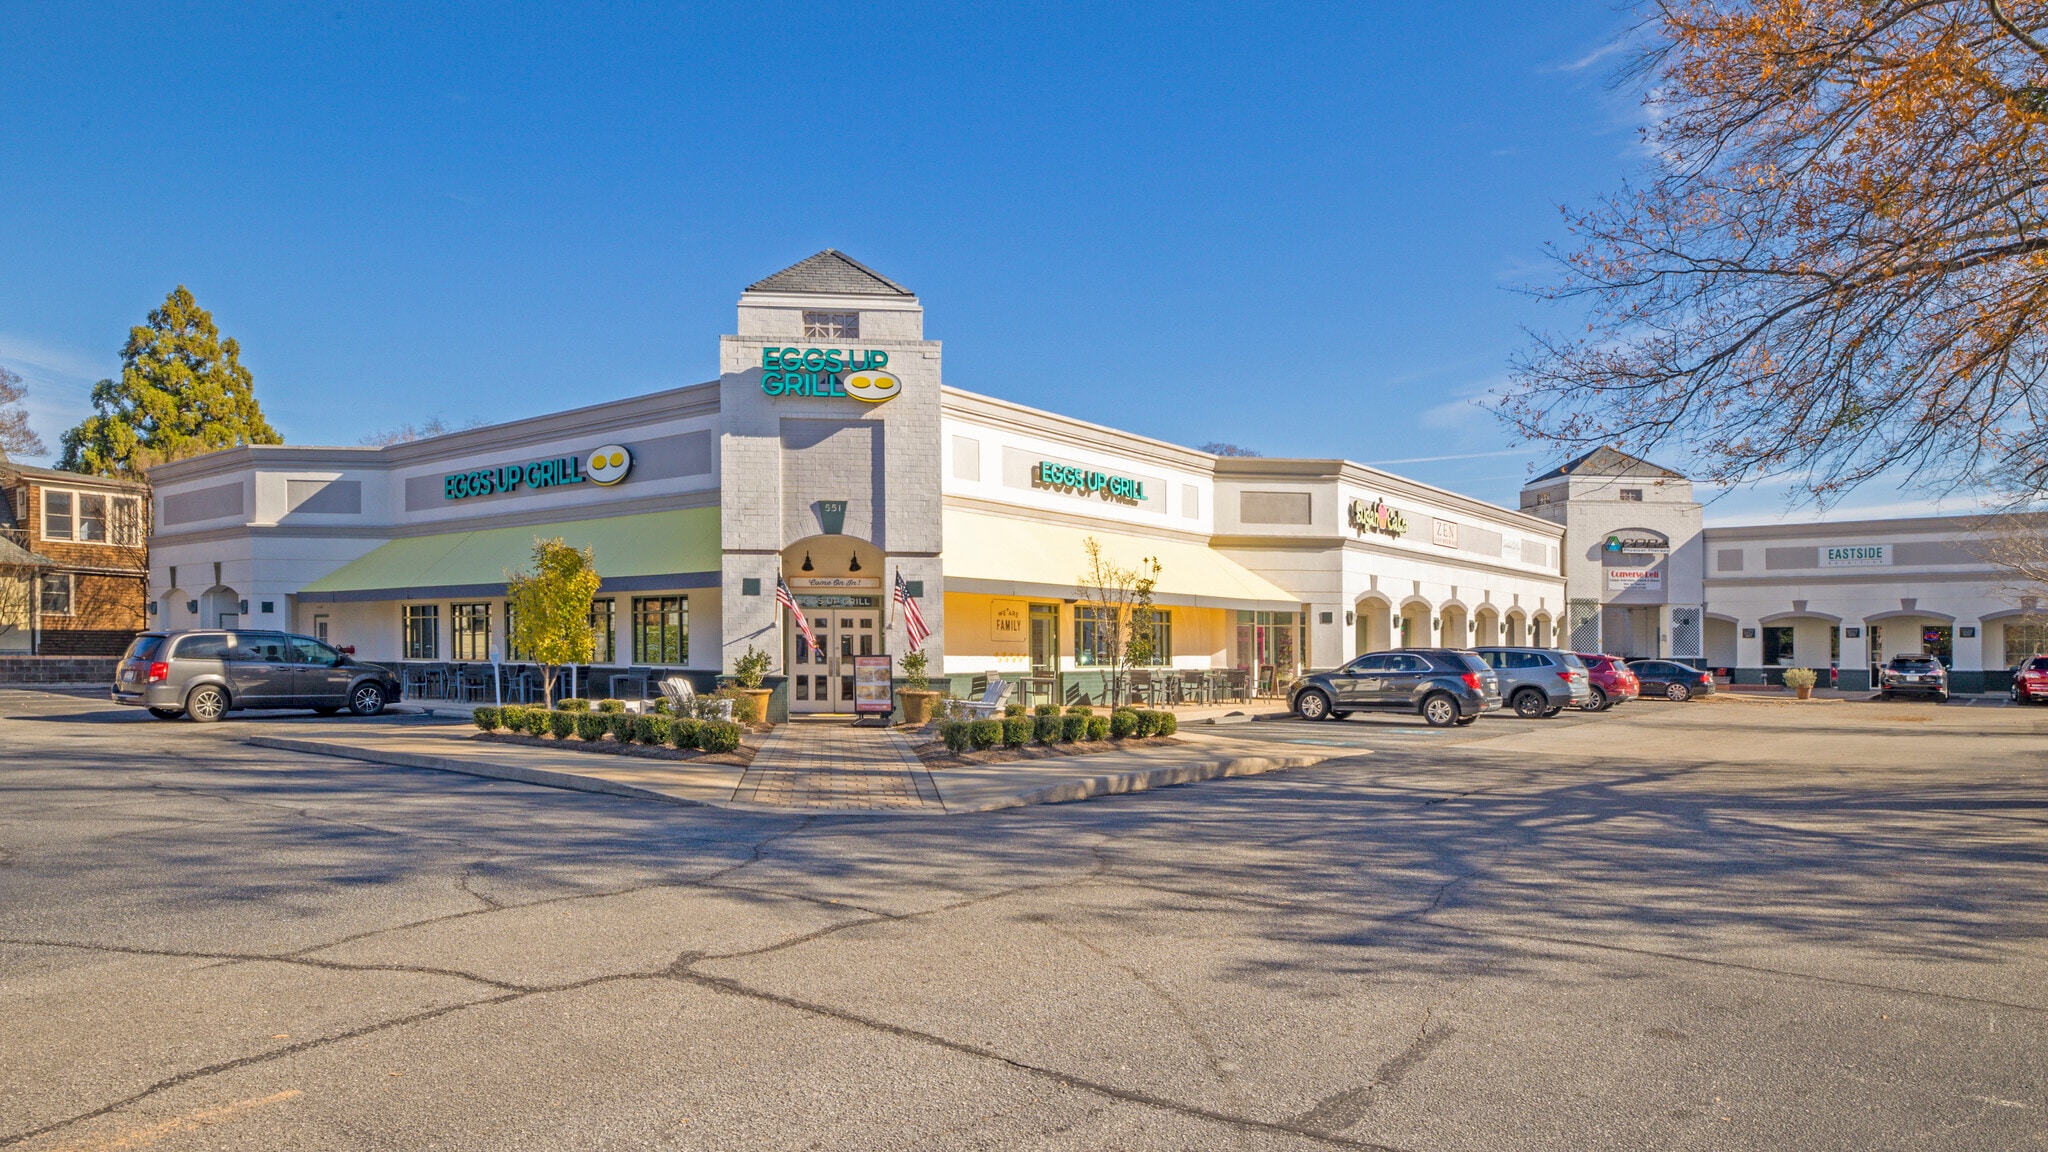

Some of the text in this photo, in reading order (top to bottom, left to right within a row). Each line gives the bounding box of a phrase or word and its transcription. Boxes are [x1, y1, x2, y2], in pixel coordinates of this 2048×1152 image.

[762, 346, 888, 373] EGGS UP
[761, 372, 848, 397] GRILL
[445, 456, 584, 499] EGGS UP GRILL
[1041, 461, 1149, 501] EGGS UP GRILL
[824, 503, 842, 512] 551
[1436, 521, 1454, 538] ZEN
[1828, 547, 1883, 560] EASTSIDE
[1611, 570, 1643, 578] Converse
[842, 597, 870, 605] GRILL
[1008, 610, 1019, 618] ARE
[996, 619, 1021, 631] FAMILY
